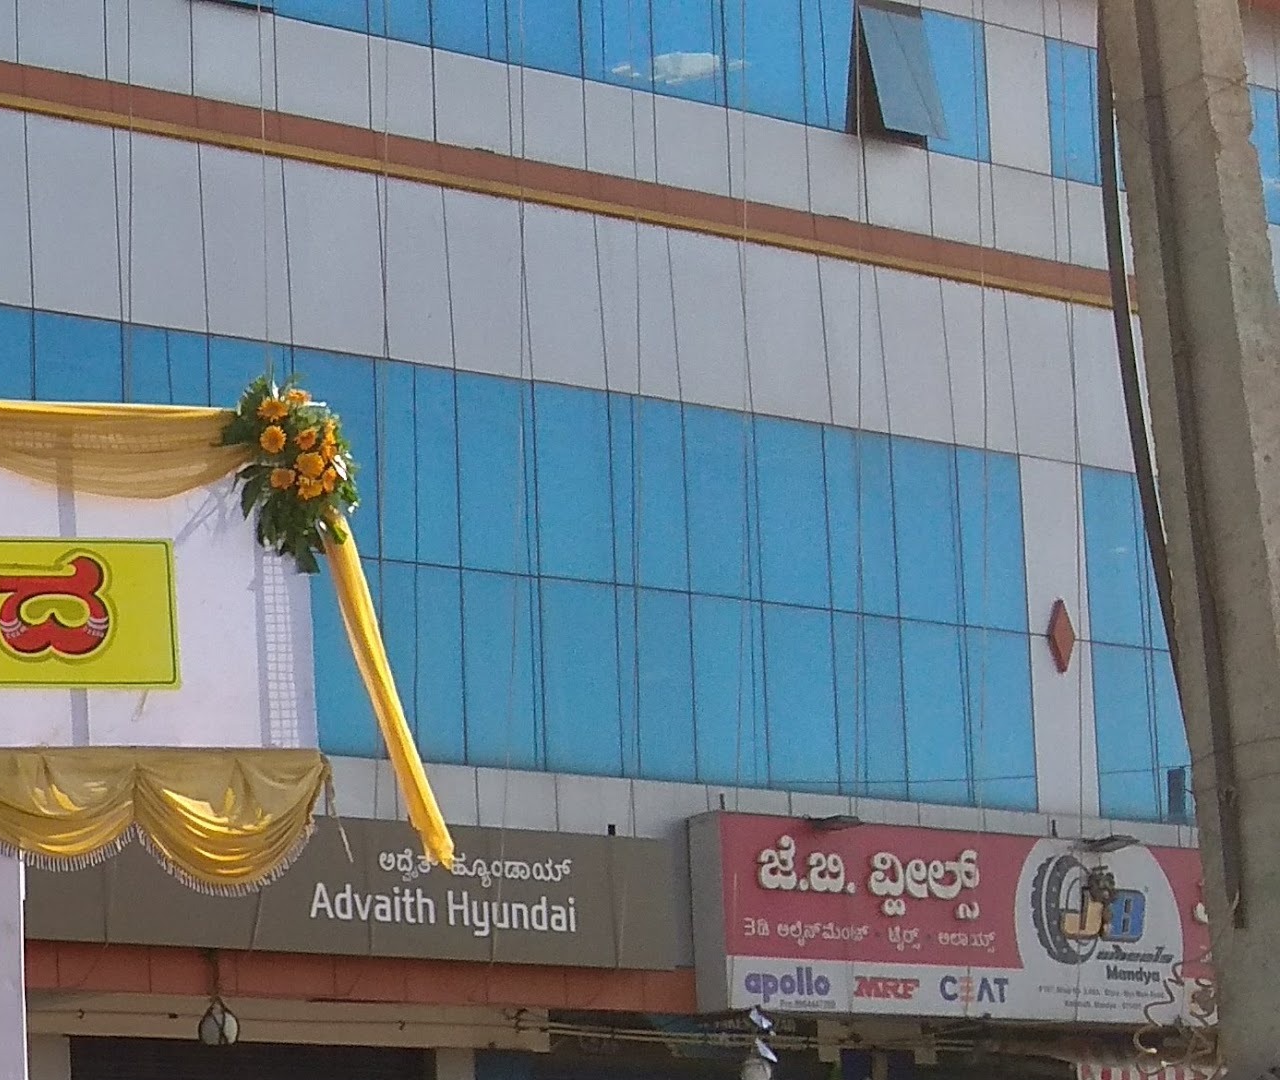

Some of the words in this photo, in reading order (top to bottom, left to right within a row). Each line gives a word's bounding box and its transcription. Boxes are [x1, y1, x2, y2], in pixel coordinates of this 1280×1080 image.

[310, 881, 436, 925] Advaith
[447, 889, 576, 938] Hyundai
[744, 966, 830, 1003] apollo
[854, 976, 920, 1000] MRF
[1106, 964, 1160, 985] Mandya
[940, 975, 1009, 1004] CEAT
